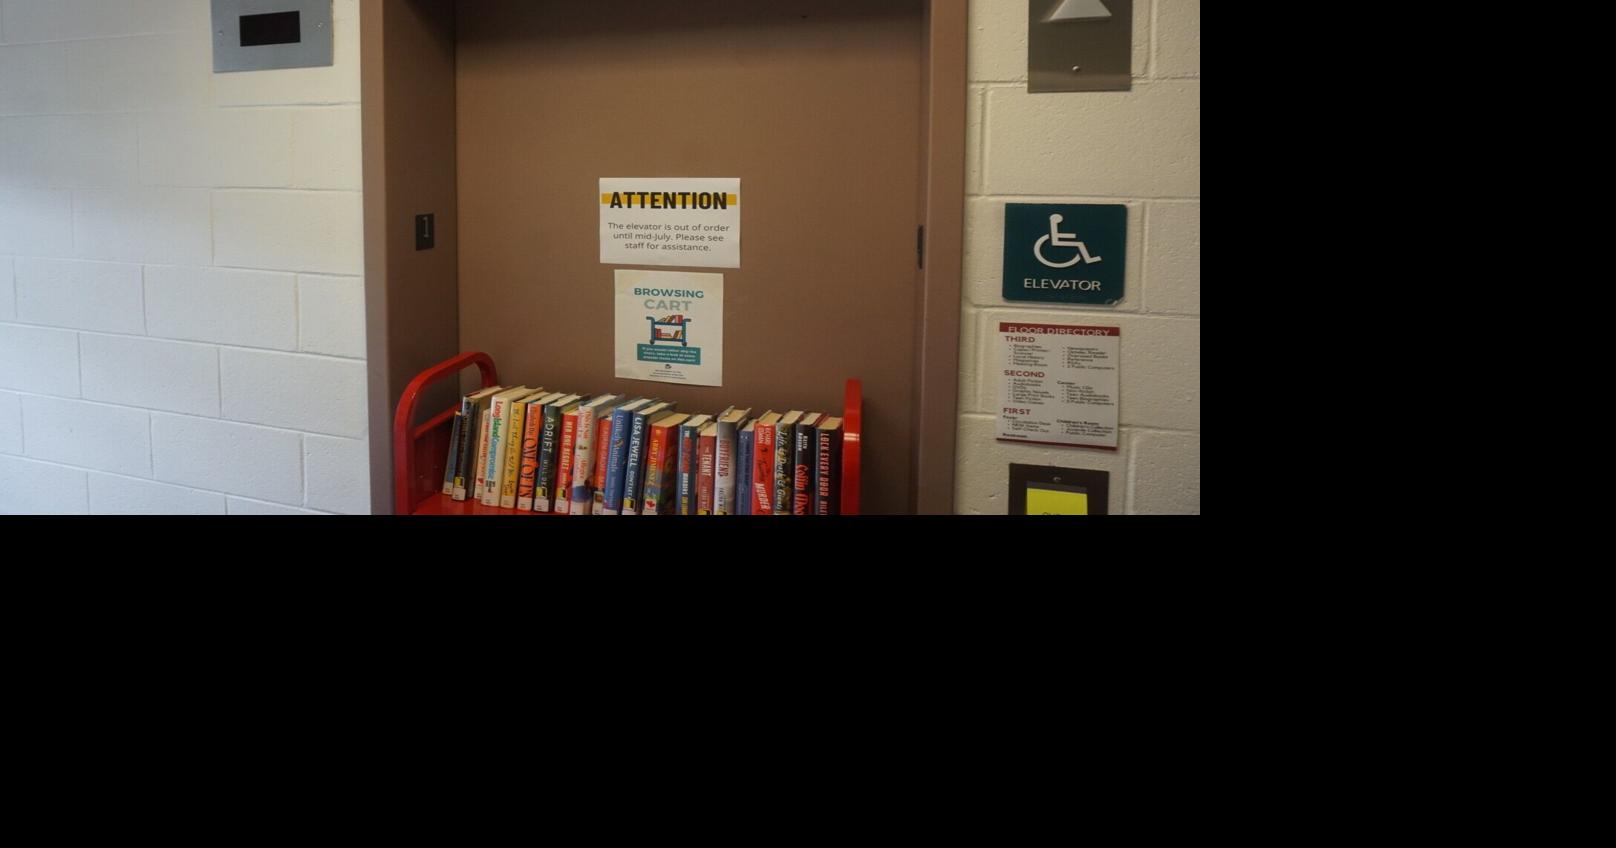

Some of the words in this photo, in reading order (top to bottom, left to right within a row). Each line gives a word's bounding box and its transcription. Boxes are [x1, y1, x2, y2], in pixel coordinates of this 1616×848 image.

[609, 191, 727, 210] ATTENTION
[422, 216, 430, 238] 1
[608, 222, 624, 230] The
[626, 223, 661, 231] elevator
[664, 223, 672, 231] is
[692, 224, 702, 232] of
[703, 224, 730, 232] order
[613, 232, 633, 240] until
[635, 233, 673, 243] mid-July.
[676, 233, 705, 242] Please
[646, 242, 659, 250] for
[661, 243, 712, 252] assistance.
[633, 287, 705, 299] BROWSING
[1023, 277, 1101, 291] ELEVATOR
[643, 298, 692, 311] CART
[1004, 335, 1036, 343] THIRD
[1008, 326, 1044, 334] FLOOR
[1047, 328, 1110, 336] DIRECTORY
[1004, 369, 1045, 378] SECOND
[492, 400, 503, 418] Long
[1003, 407, 1031, 415] FIRST
[492, 418, 502, 439] Island
[543, 416, 554, 454] ADRIFT
[565, 421, 573, 432] HER
[614, 415, 623, 442] Unlikely
[633, 417, 642, 435] LISA
[820, 433, 830, 451] LOCK
[562, 447, 572, 471] REGRET
[611, 445, 620, 472] Animals
[629, 436, 640, 468] JEWELL
[719, 439, 731, 477] BOYFRIEND
[701, 454, 712, 477] TENANT
[819, 452, 829, 475] EVERY
[796, 464, 809, 491] Coffin
[819, 476, 829, 496] DOOR
[754, 482, 771, 510] MURDER
[795, 494, 809, 515] Moo
